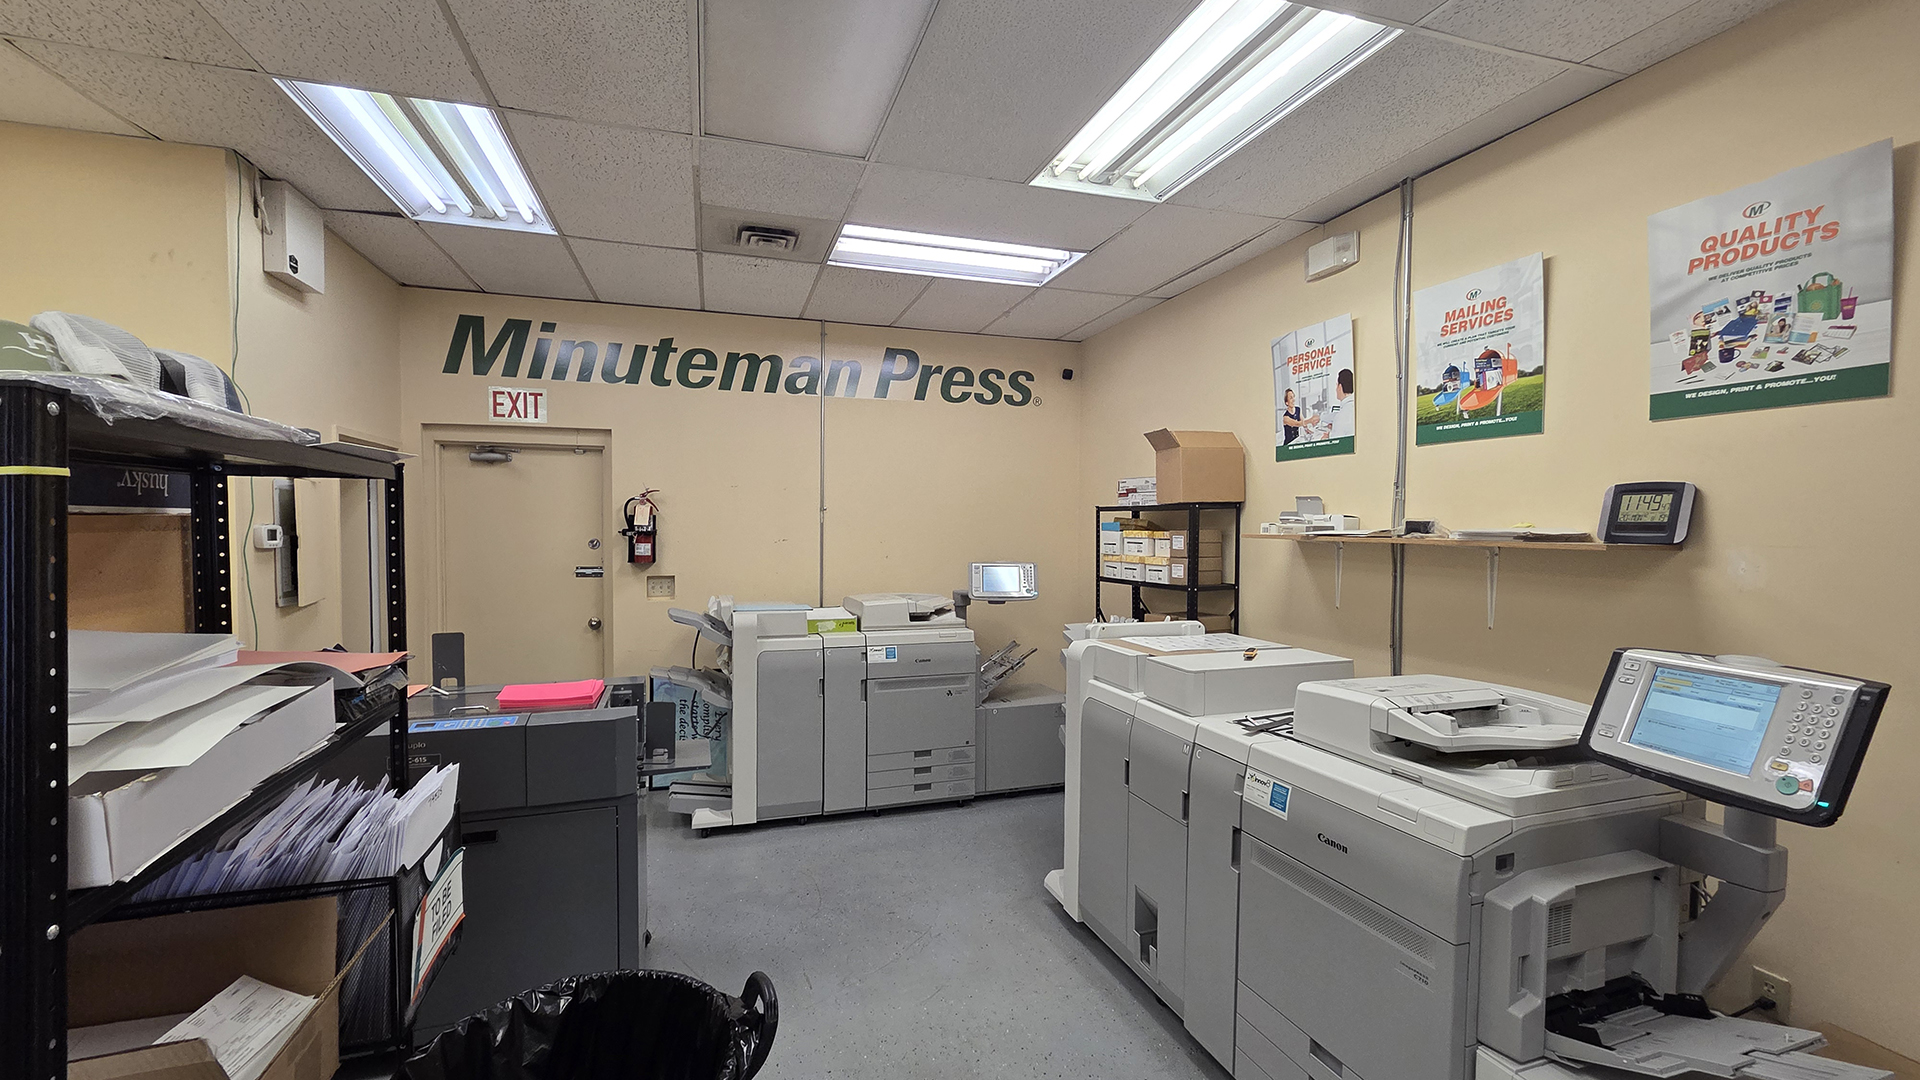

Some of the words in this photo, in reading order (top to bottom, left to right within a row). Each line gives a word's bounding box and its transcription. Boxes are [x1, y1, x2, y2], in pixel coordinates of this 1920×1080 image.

[1700, 204, 1825, 253] QUALITY
[1687, 220, 1840, 276] PRODUCTS
[1718, 268, 1745, 279] DELIVER
[1745, 261, 1774, 272] QUALITY
[1774, 252, 1813, 266] PRODUCTS
[1730, 267, 1773, 281] COMPETITIVE
[1774, 261, 1799, 271] PRICES
[1444, 296, 1507, 324] MAILING
[1440, 308, 1514, 338] SERVICES
[442, 314, 863, 397] Minuteman
[1286, 344, 1337, 368] PERSONAL
[1291, 355, 1332, 376] SERVICE
[1698, 388, 1729, 398] DESIGN,
[1730, 385, 1754, 394] PRINT
[492, 391, 543, 419] EXIT
[679, 699, 690, 715] the
[408, 741, 426, 750] uplo
[1182, 744, 1190, 755] M
[1196, 749, 1202, 759] C
[1317, 832, 1348, 854] Canon
[431, 897, 441, 922] TO
[442, 880, 452, 906] BE
[431, 900, 452, 943] FILED
